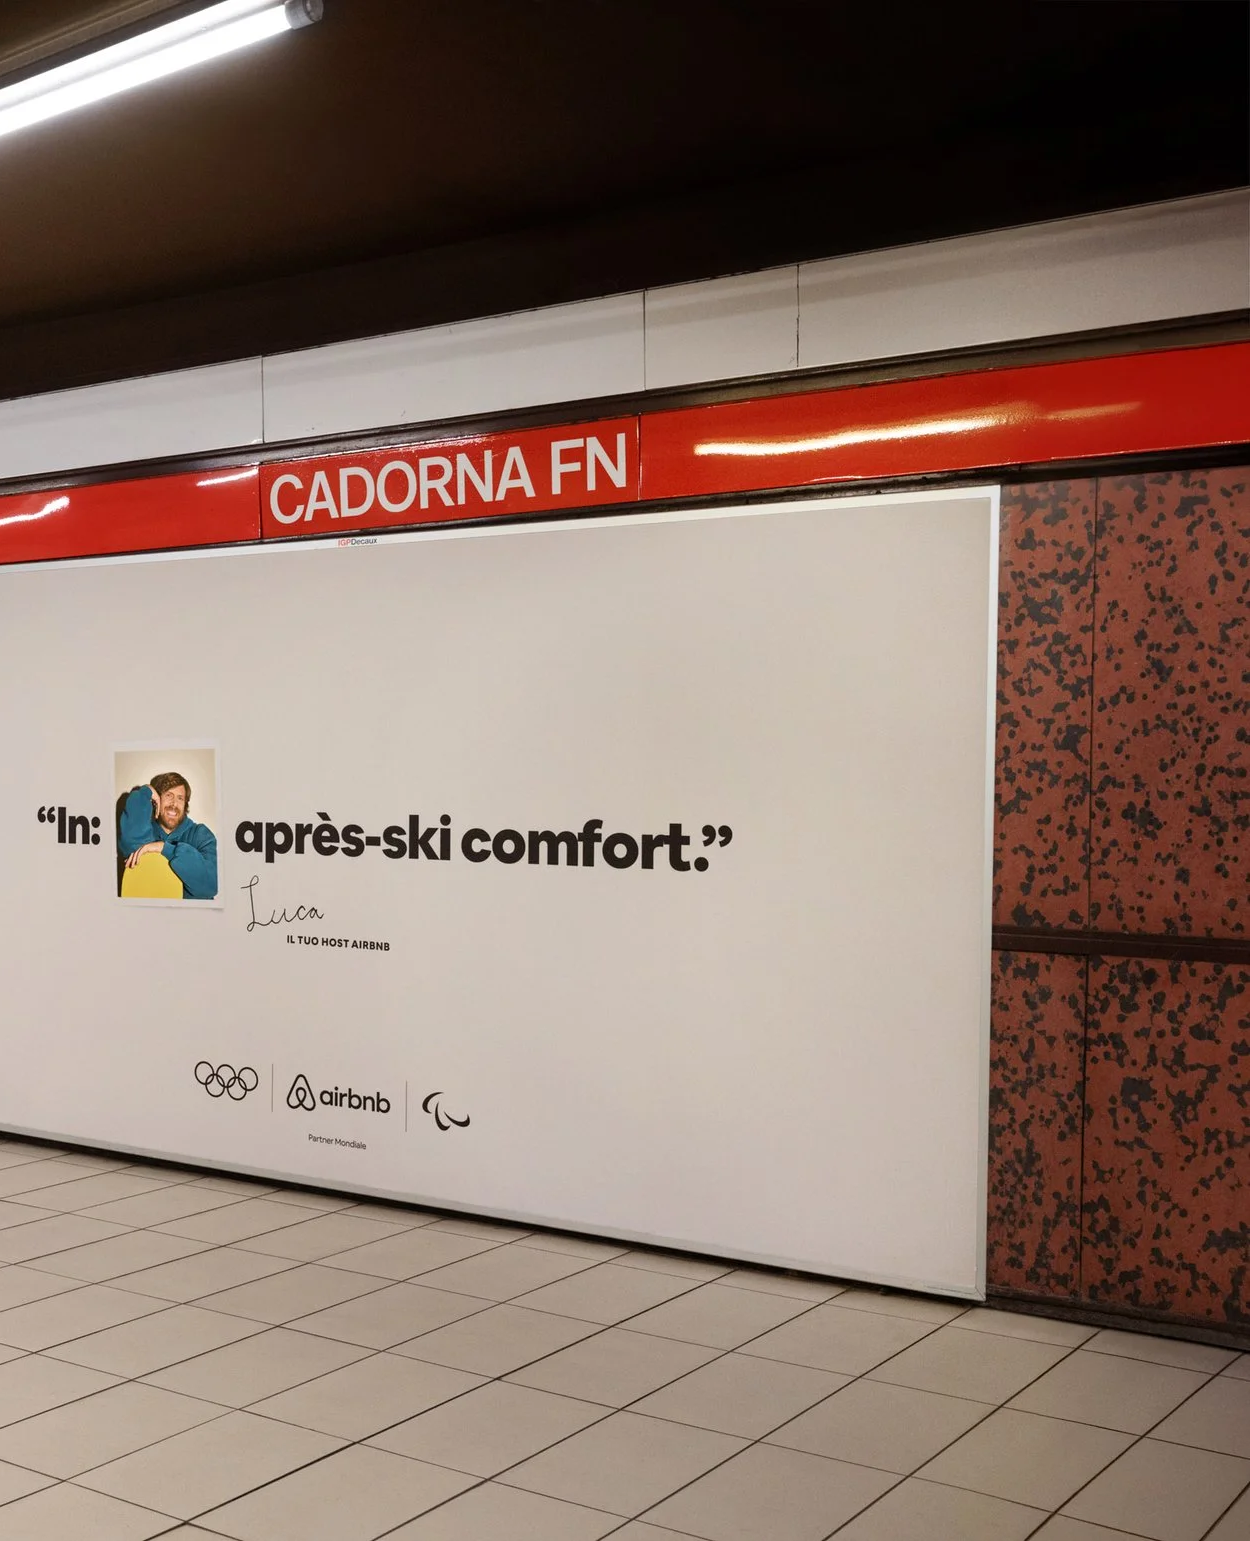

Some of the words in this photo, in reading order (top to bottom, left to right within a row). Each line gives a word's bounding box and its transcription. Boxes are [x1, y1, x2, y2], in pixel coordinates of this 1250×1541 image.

[269, 446, 536, 524] CADORNA
[551, 433, 626, 494] FN
[338, 538, 377, 546] IGPDecaux
[37, 806, 101, 845] “In:
[235, 812, 451, 863] après-ski
[461, 819, 733, 872] comfort.”
[240, 875, 324, 932] Luca
[287, 935, 295, 944] IL
[297, 936, 319, 945] TUO
[322, 937, 349, 948] HOST
[351, 940, 390, 951] AIRBNB
[319, 1086, 390, 1113] airbnb
[308, 1134, 334, 1144] Partner
[335, 1138, 366, 1150] Mondiale
